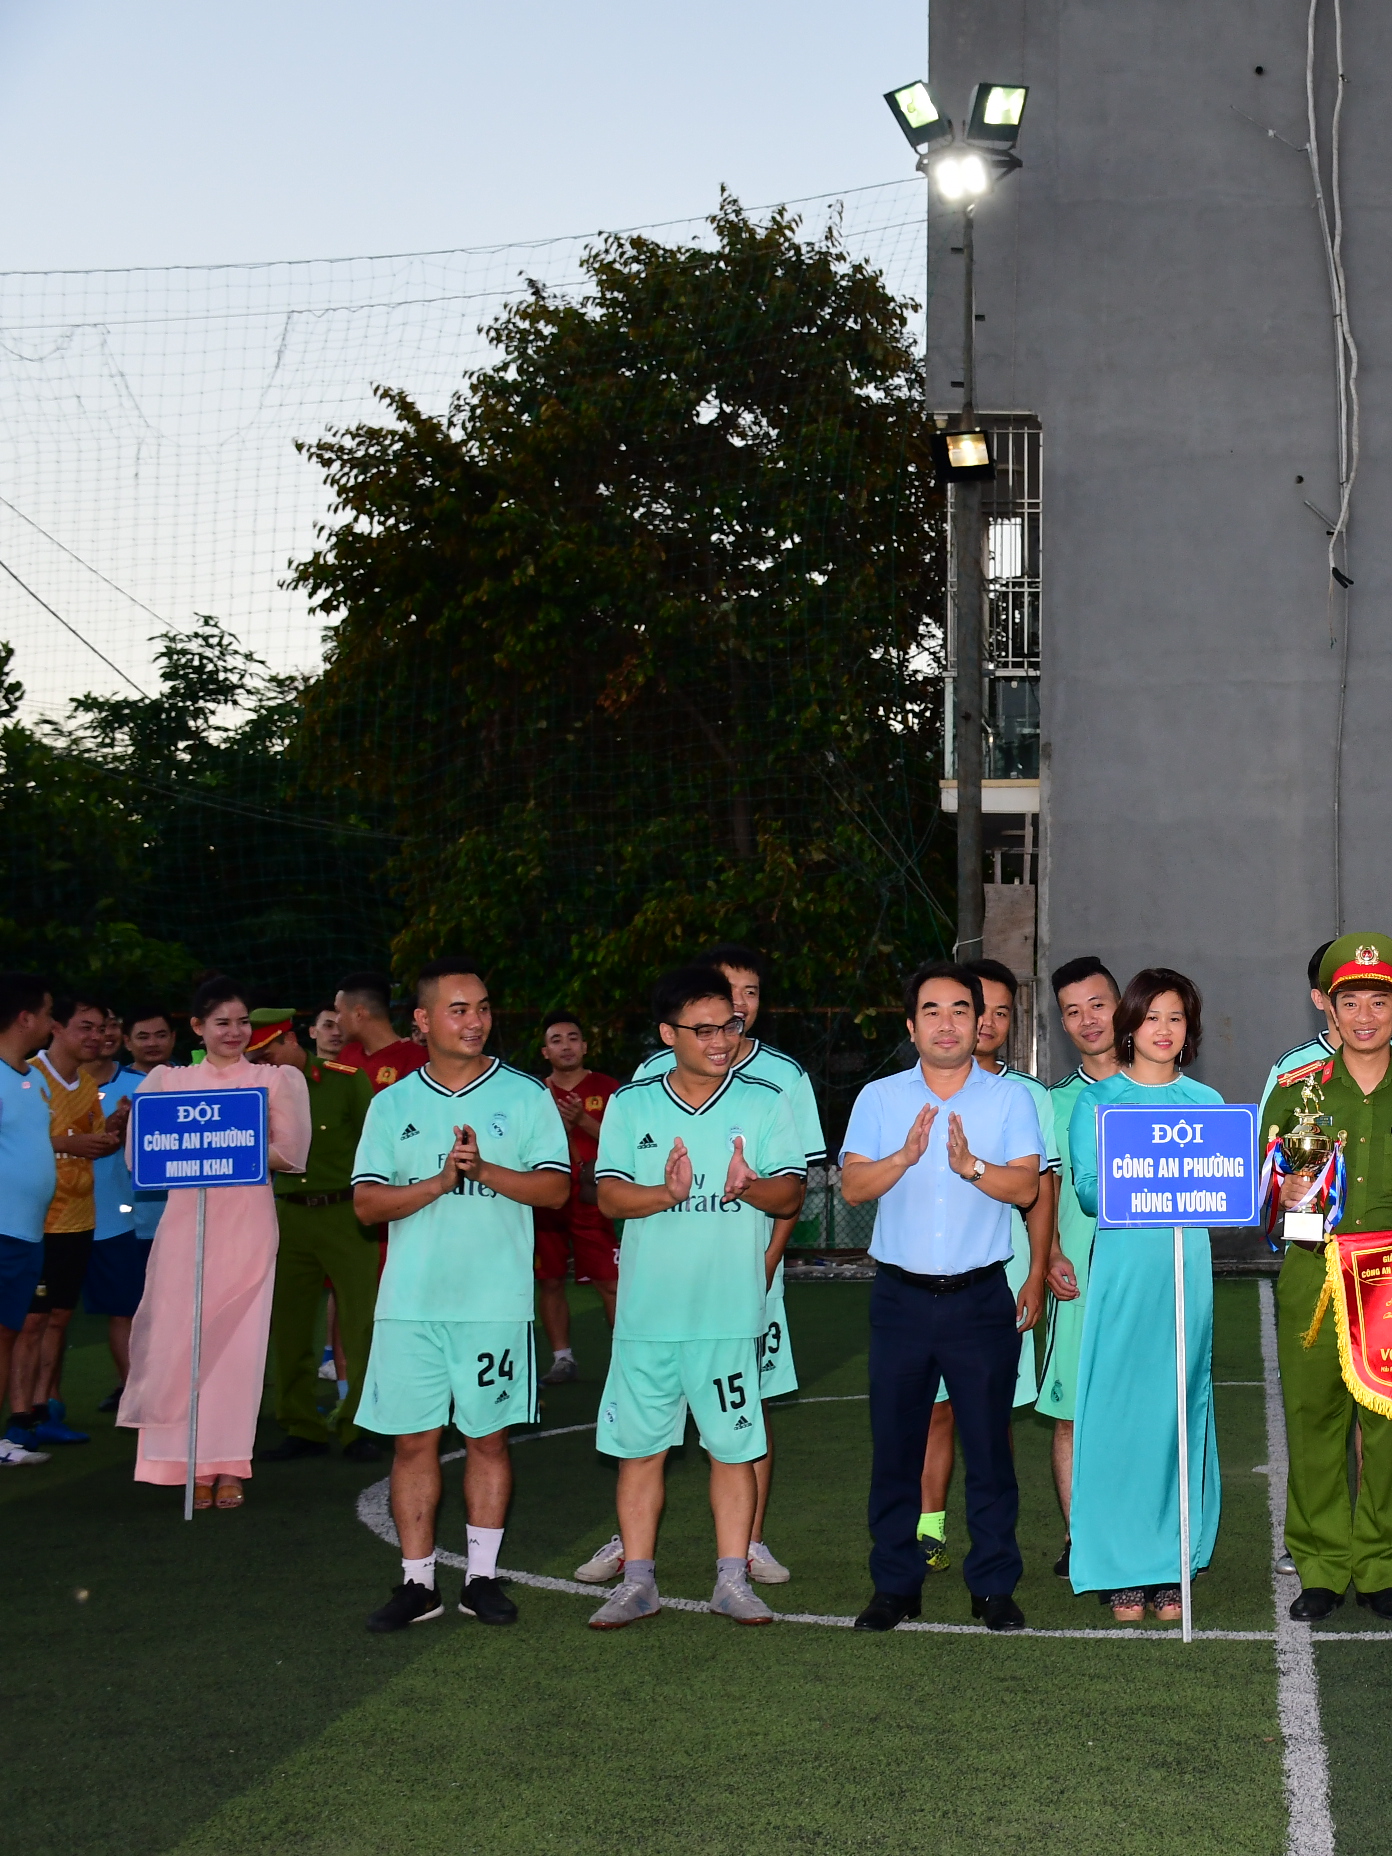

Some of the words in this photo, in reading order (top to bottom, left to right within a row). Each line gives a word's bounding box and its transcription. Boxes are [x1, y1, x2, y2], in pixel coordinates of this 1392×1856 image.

[177, 1101, 221, 1125] ĐỘI
[143, 1131, 179, 1151] CÔNG
[182, 1132, 200, 1149] AN
[203, 1126, 255, 1149] PHƯỜNG
[1151, 1119, 1204, 1148] ĐỘI
[166, 1160, 200, 1178] MINH
[203, 1158, 233, 1176] KHAI
[1112, 1154, 1154, 1178] CÔNG
[1158, 1157, 1180, 1178] AN
[1183, 1152, 1245, 1178] PHƯỜNG
[1131, 1188, 1173, 1213] HÙNG
[1176, 1190, 1227, 1212] VƯƠNG
[477, 1348, 514, 1387] 24
[712, 1371, 747, 1413] 15
